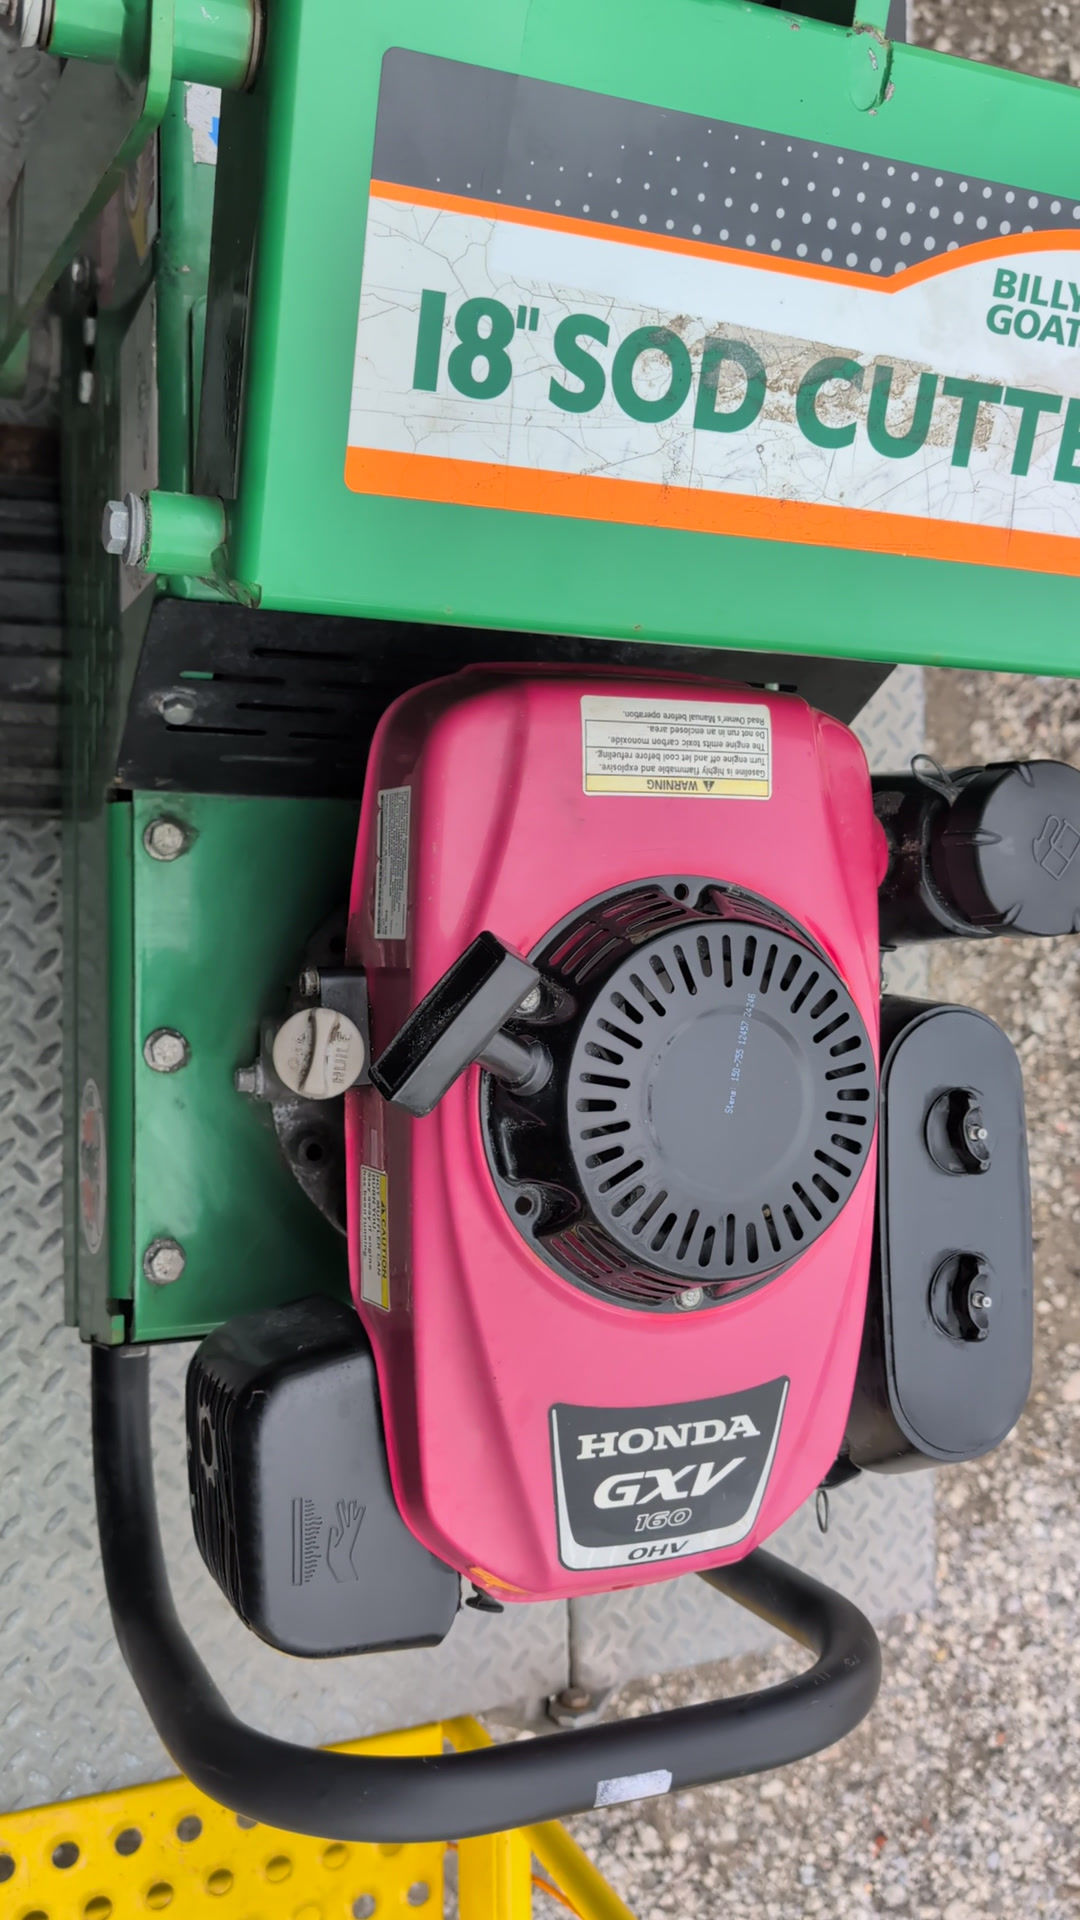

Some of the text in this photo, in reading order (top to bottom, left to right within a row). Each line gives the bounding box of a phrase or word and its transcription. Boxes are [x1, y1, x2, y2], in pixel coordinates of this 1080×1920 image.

[993, 268, 1080, 313] BILLY
[986, 304, 1080, 348] GOAT
[411, 288, 540, 401] 18"
[547, 312, 768, 434] SOD
[622, 710, 765, 725] Read Owner's Manual before operation.
[670, 726, 704, 736] enclosed
[608, 736, 765, 751] The engine emits toxic carbon monoxide.
[635, 752, 661, 760] before
[682, 754, 692, 762] let
[694, 754, 708, 763] and
[710, 755, 721, 764] off
[723, 754, 748, 764] engine
[749, 757, 765, 766] Turn
[599, 763, 638, 773] explosive.
[640, 765, 655, 774] and
[658, 765, 700, 776] flammable
[702, 765, 724, 776] highly
[735, 768, 766, 778] Gasoline
[647, 779, 698, 792] WARNING
[731, 1048, 744, 1082] 150-755
[738, 1020, 750, 1045] 12457
[744, 992, 756, 1018] 24246
[576, 1414, 761, 1460] HONDA
[593, 1456, 747, 1510] GXV
[634, 1507, 693, 1533] 160
[627, 1539, 691, 1561] OHV
